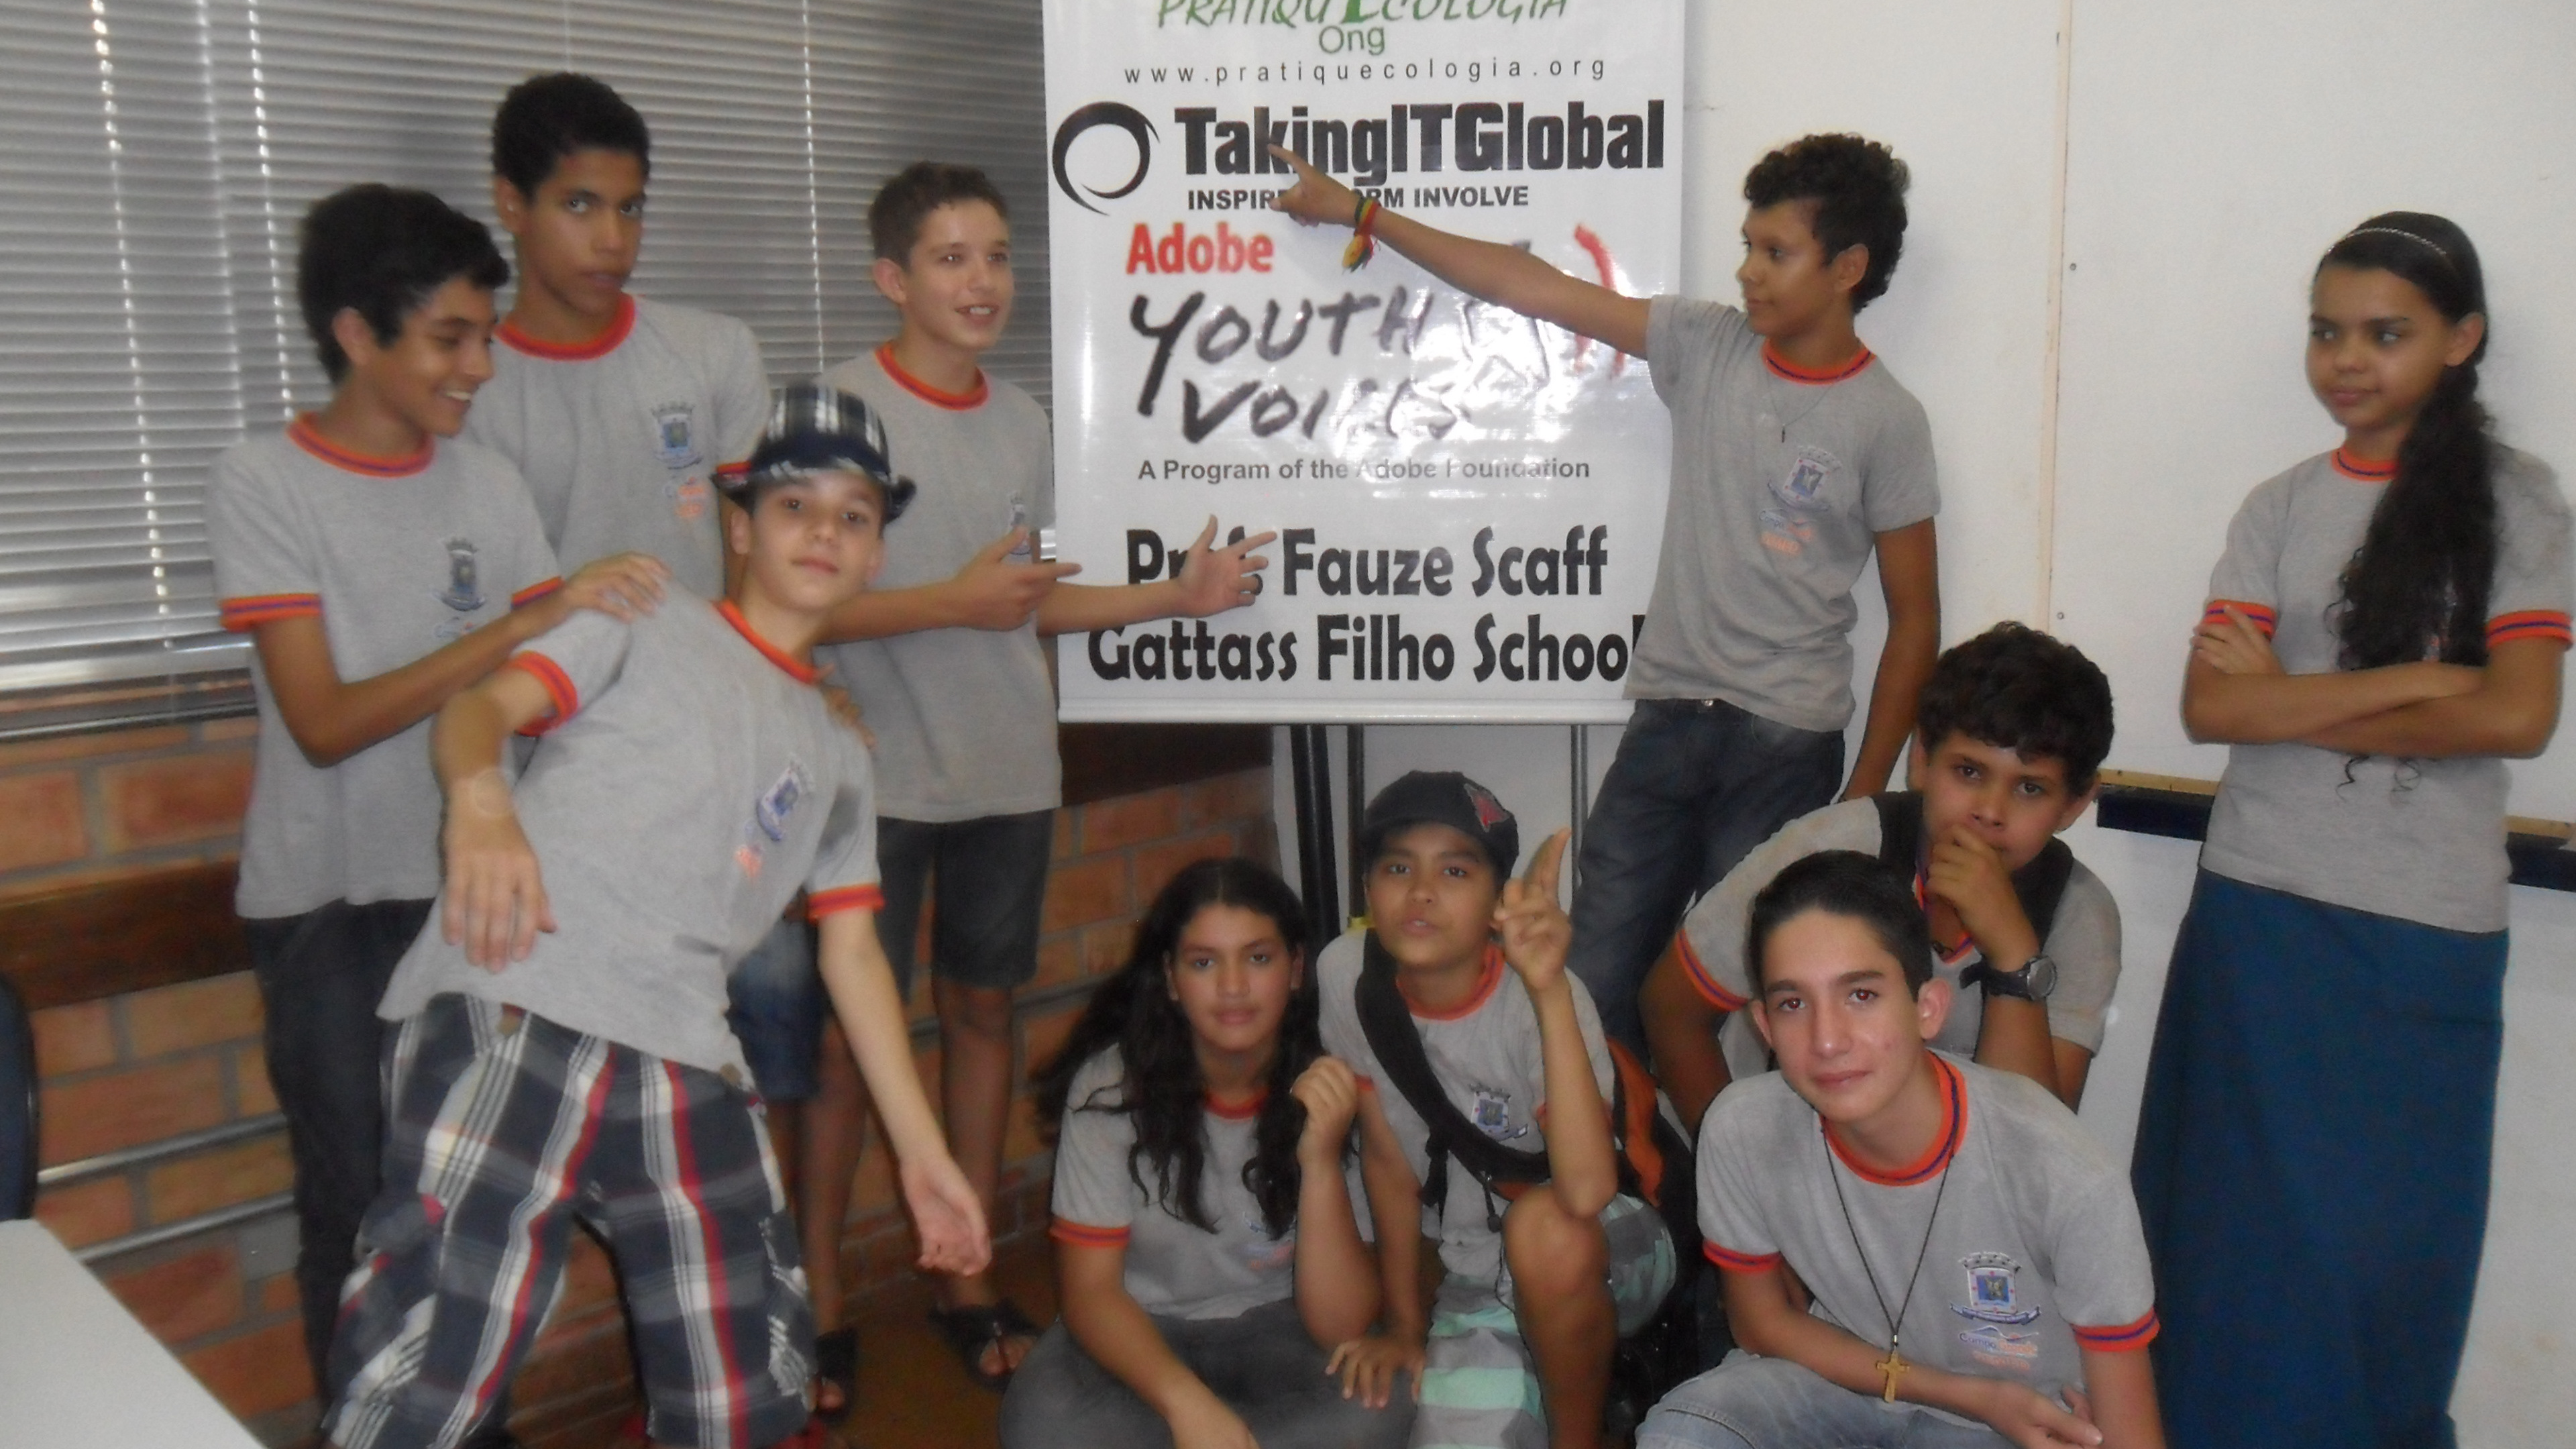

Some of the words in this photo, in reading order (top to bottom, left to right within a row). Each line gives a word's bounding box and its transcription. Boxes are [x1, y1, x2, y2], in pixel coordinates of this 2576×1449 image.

[1318, 25, 1385, 56] Ong
[1124, 56, 1605, 85] www.pratiquecologia.org
[1174, 99, 1665, 186] TakingITGlobal
[1188, 189, 1289, 210] INSPIR
[1415, 186, 1529, 207] INVOLVE
[1126, 222, 1274, 274] Adobe
[1130, 285, 1434, 417] YOUTH
[1138, 460, 1156, 480] A
[1164, 460, 1269, 484] Program
[1279, 458, 1303, 479] of
[1310, 459, 1348, 479] the
[1283, 527, 1453, 596] Fauze
[1471, 524, 1609, 596] Scaff
[1088, 619, 1297, 682] Gattass
[1317, 613, 1455, 681] Filho
